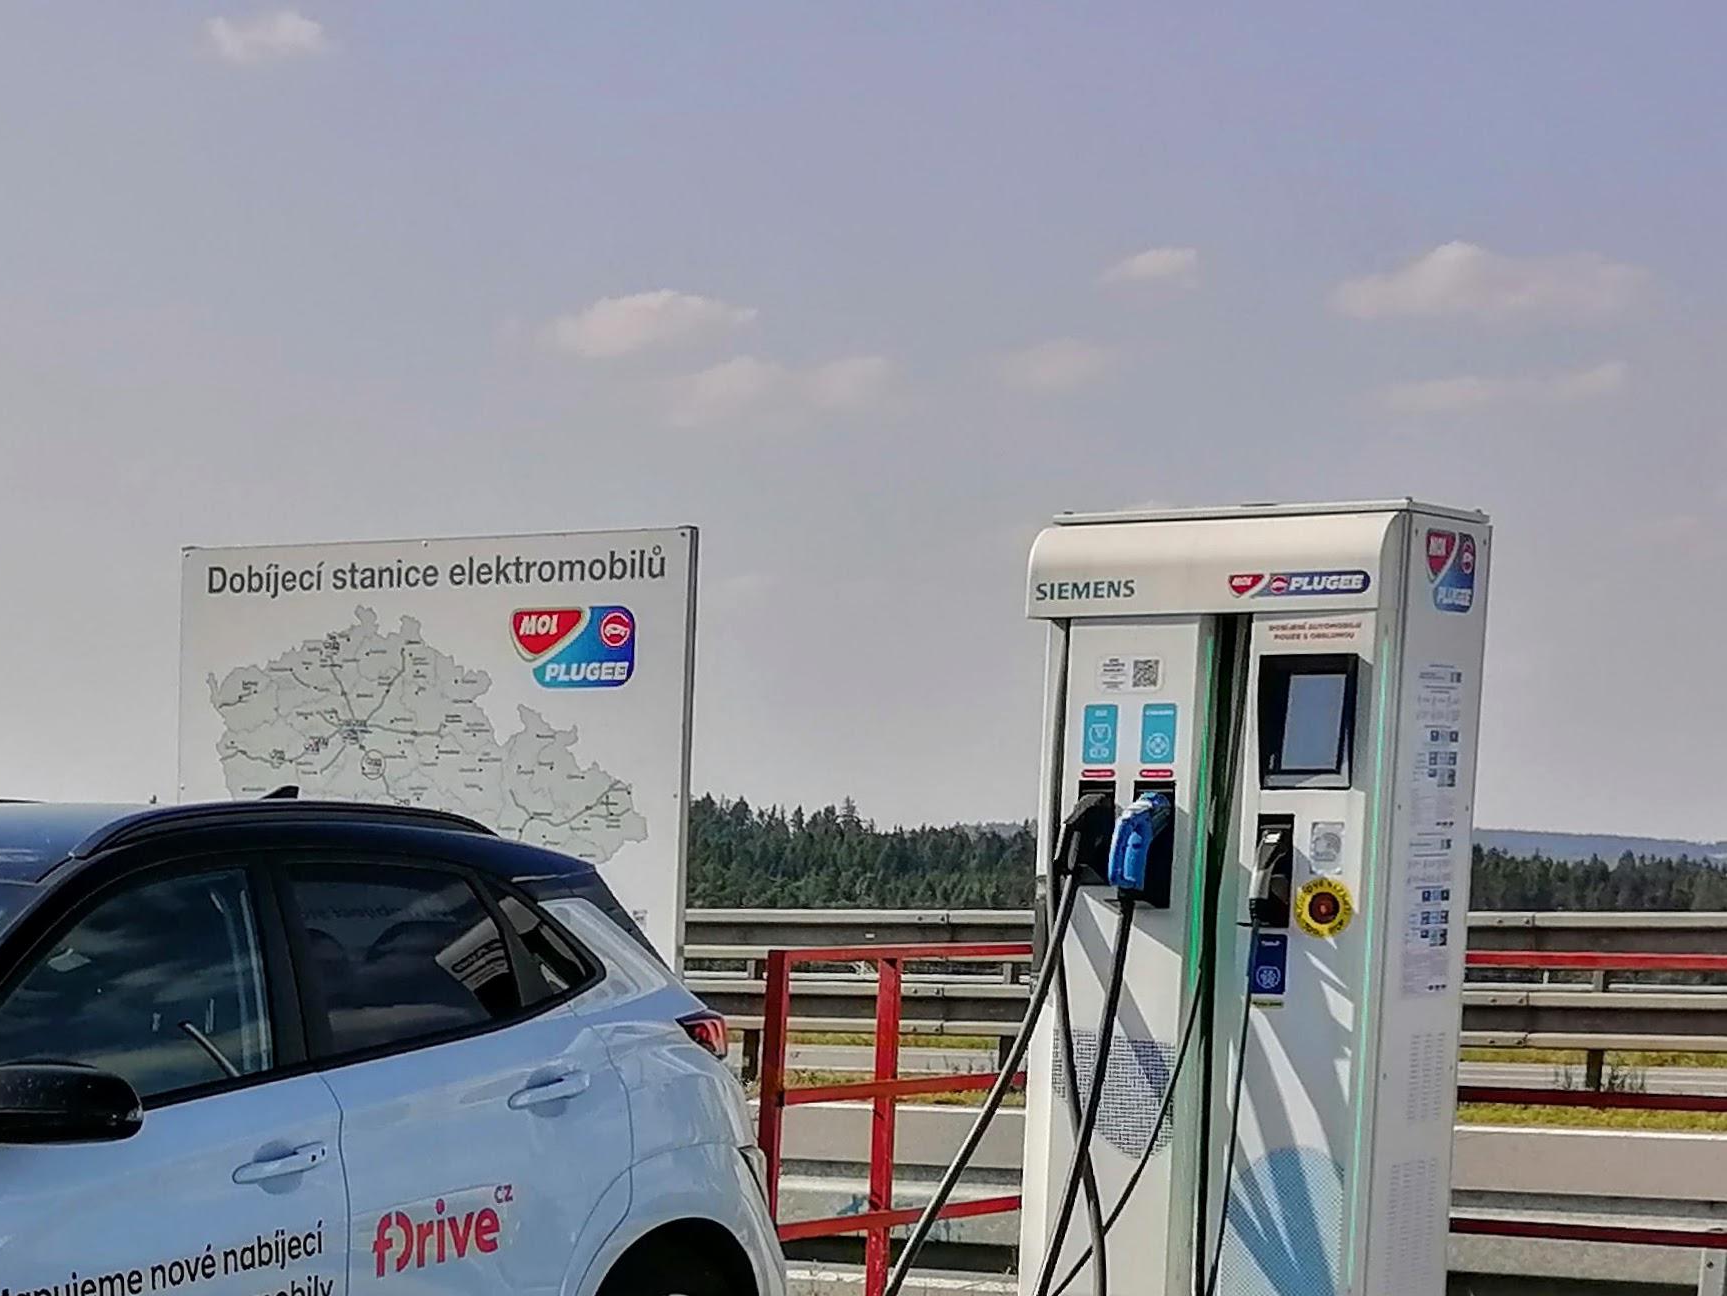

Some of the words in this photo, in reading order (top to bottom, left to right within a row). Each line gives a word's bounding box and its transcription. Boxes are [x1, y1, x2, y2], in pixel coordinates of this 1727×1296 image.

[207, 560, 325, 599] Dobíjecí
[331, 559, 439, 590] stanice
[449, 545, 666, 586] elektromobilů
[1289, 575, 1365, 591] PLUGEE
[1035, 579, 1136, 601] SIEMENS
[544, 661, 629, 682] PLUGEE
[150, 1243, 216, 1290] nové
[223, 1219, 323, 1275] nabíjecí
